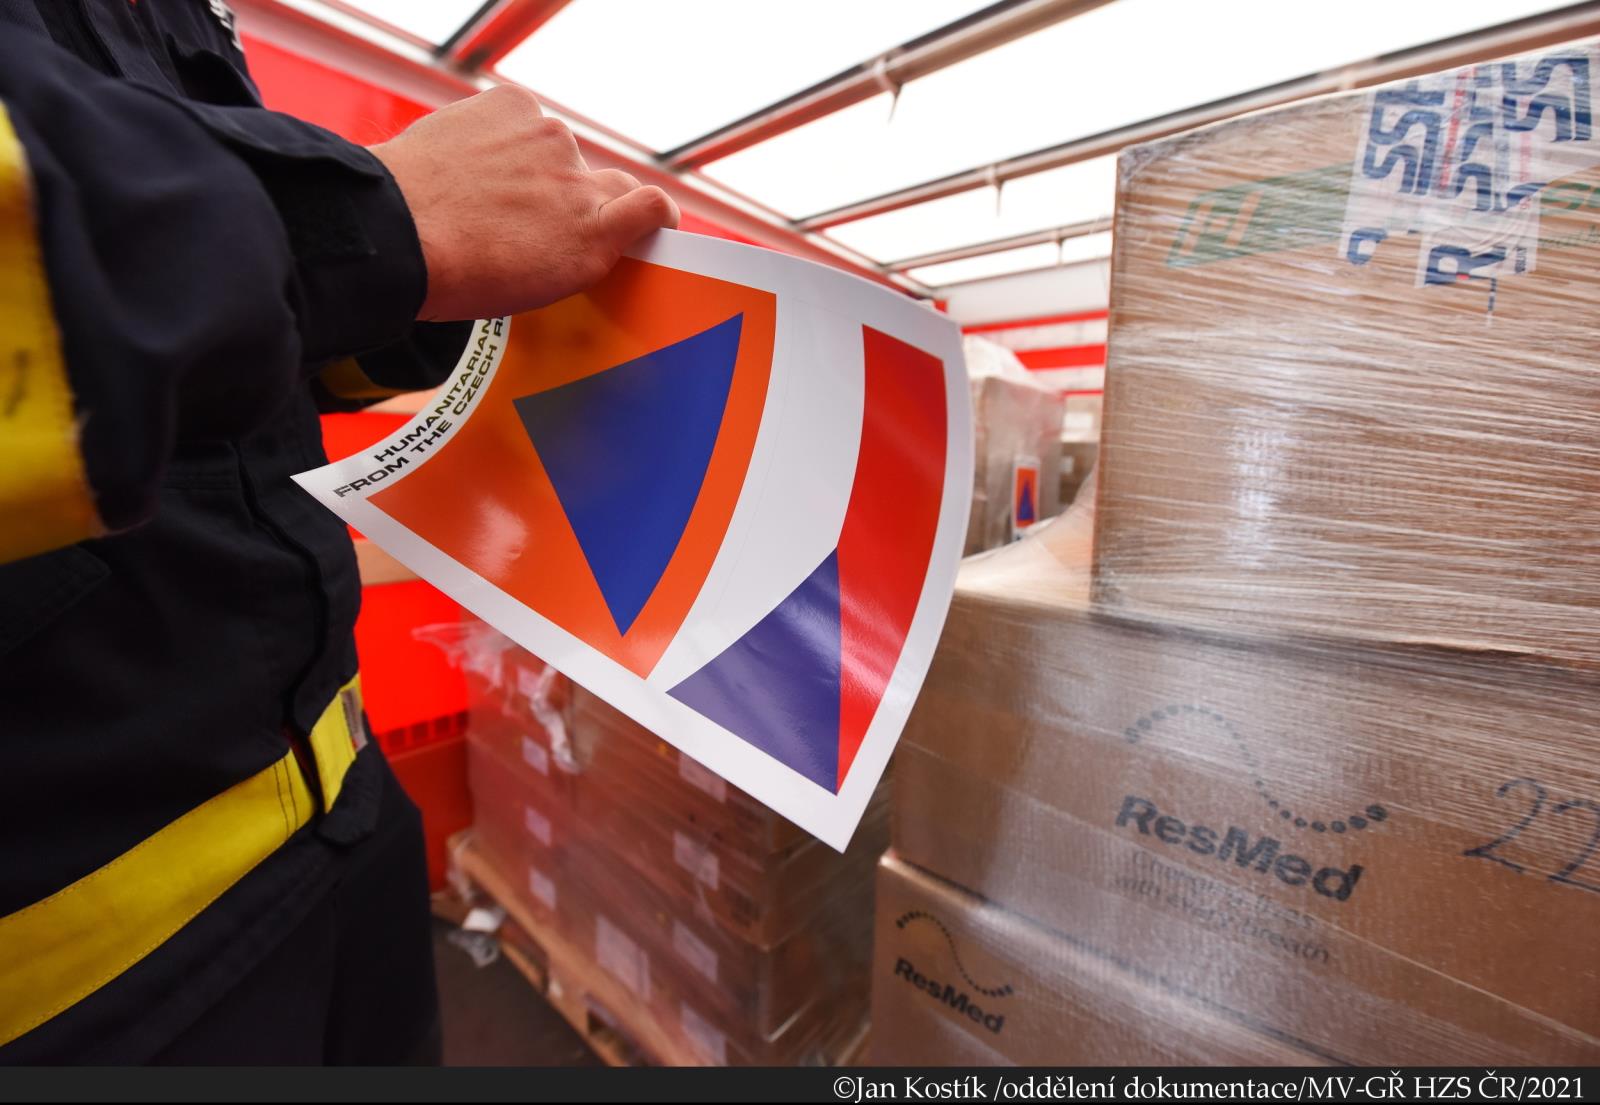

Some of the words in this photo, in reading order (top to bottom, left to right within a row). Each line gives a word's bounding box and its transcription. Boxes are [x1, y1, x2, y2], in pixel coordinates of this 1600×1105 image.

[333, 457, 410, 498] FROM
[410, 421, 452, 453] THE
[454, 345, 498, 416] CZECH
[374, 318, 491, 462] HUMANITARIAN
[1116, 795, 1364, 903] ResMed
[894, 957, 1005, 1034] ResMed
